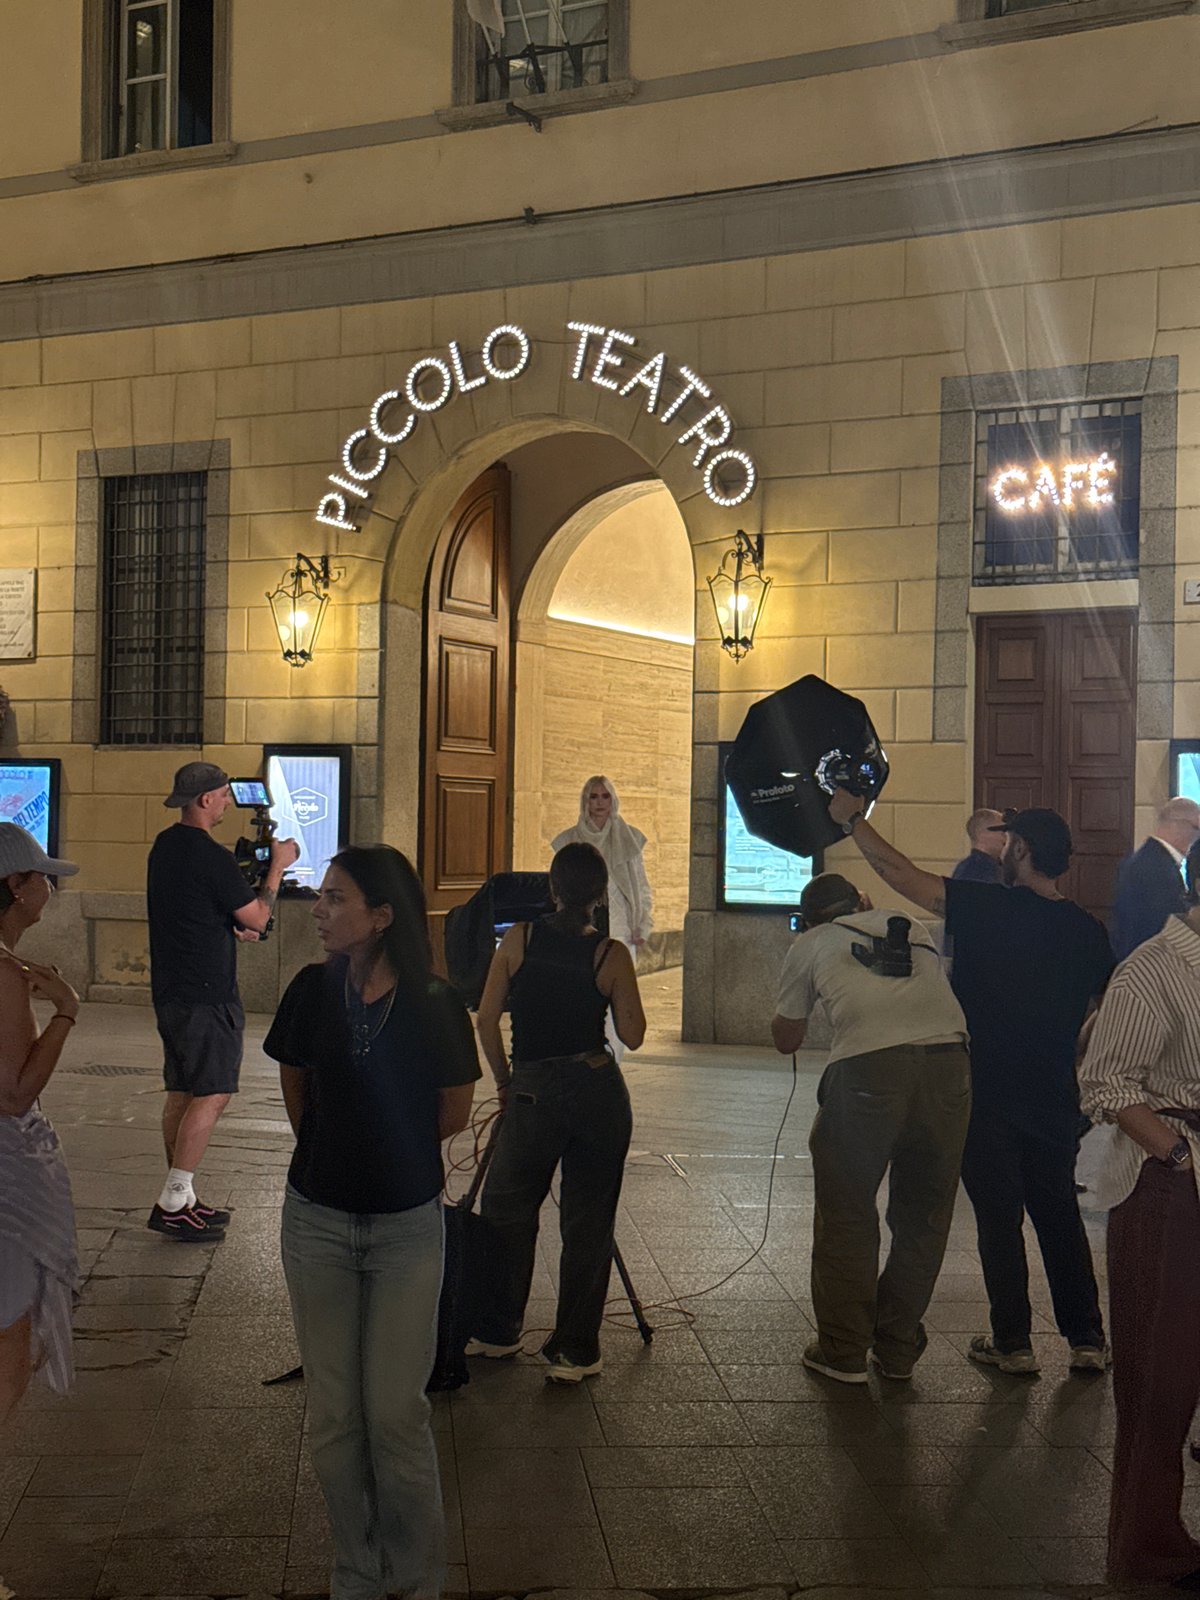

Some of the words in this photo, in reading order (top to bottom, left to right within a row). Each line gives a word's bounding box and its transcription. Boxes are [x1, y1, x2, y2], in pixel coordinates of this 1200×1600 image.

[315, 324, 529, 532] PICCOLO
[567, 321, 756, 507] TEATRO
[991, 451, 1116, 511] CAFÉ
[758, 785, 795, 797] Profoto
